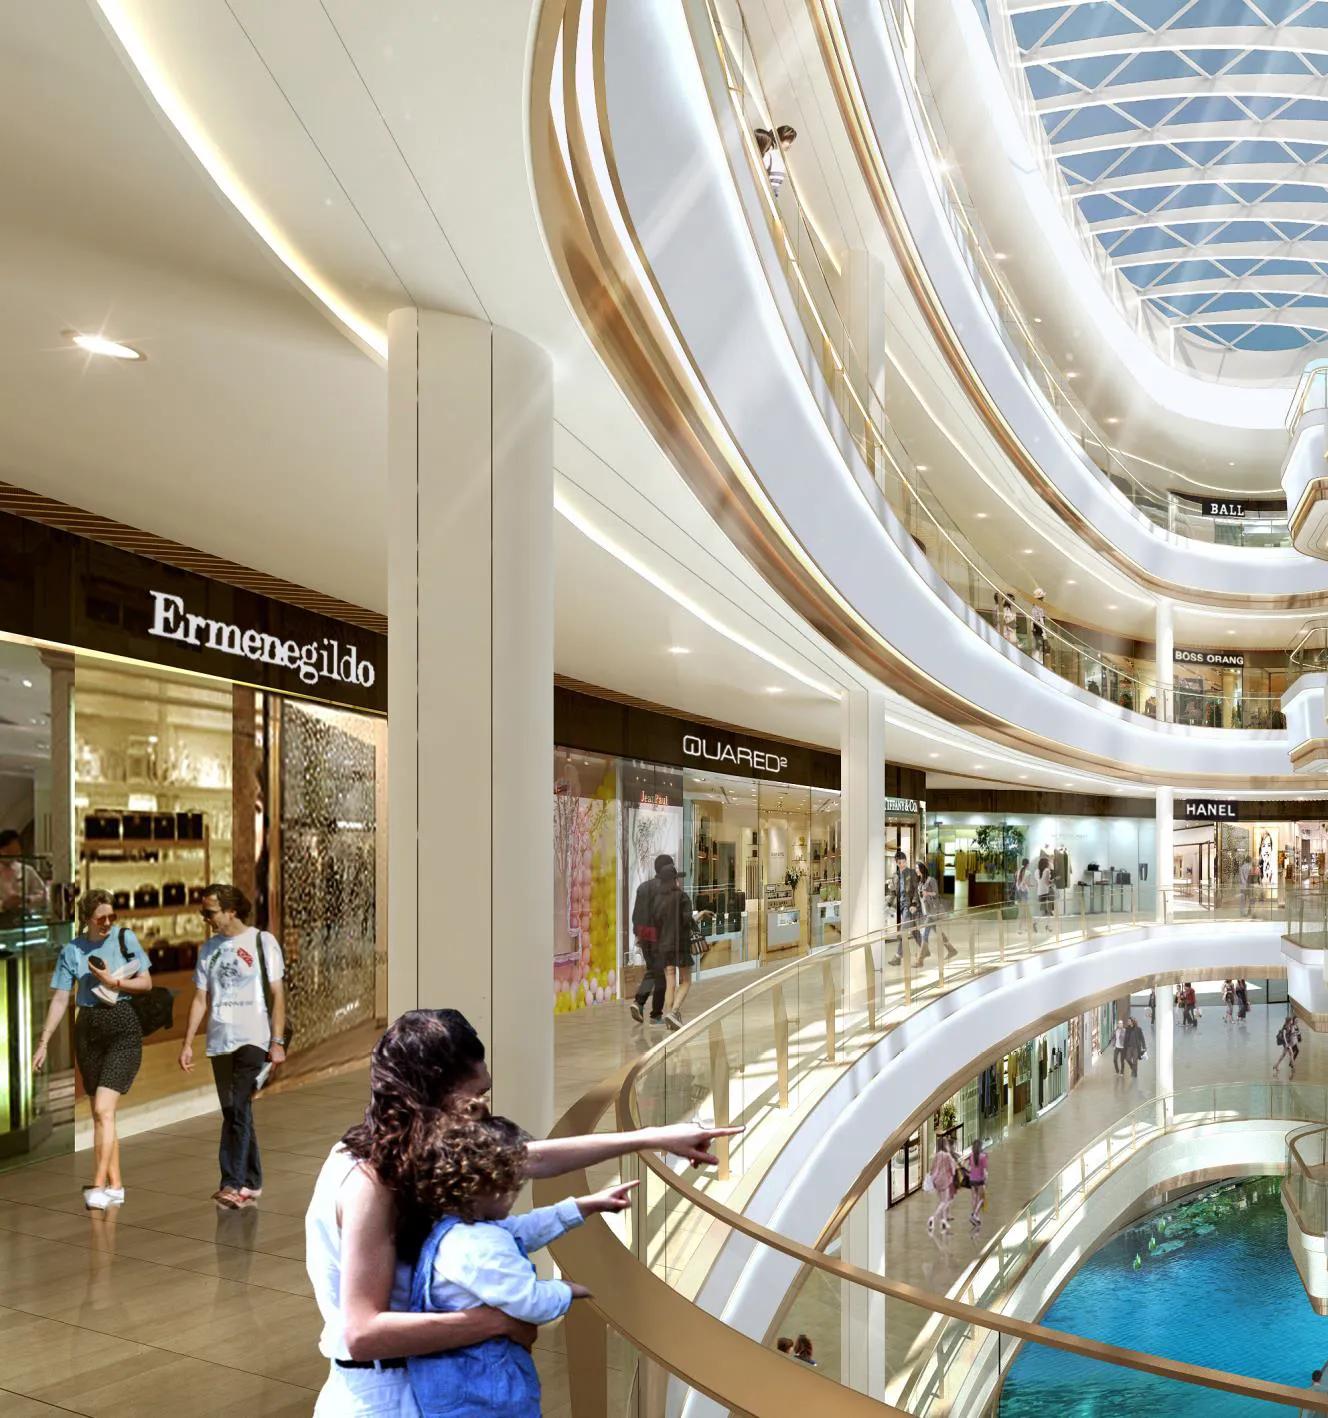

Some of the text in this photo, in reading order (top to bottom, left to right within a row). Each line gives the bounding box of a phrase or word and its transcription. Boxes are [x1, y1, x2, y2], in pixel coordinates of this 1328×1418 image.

[1210, 503, 1245, 516] BALL
[148, 590, 375, 688] Ermenegildo
[1175, 650, 1244, 665] BOSS ORANG
[1186, 803, 1236, 816] HANEL
